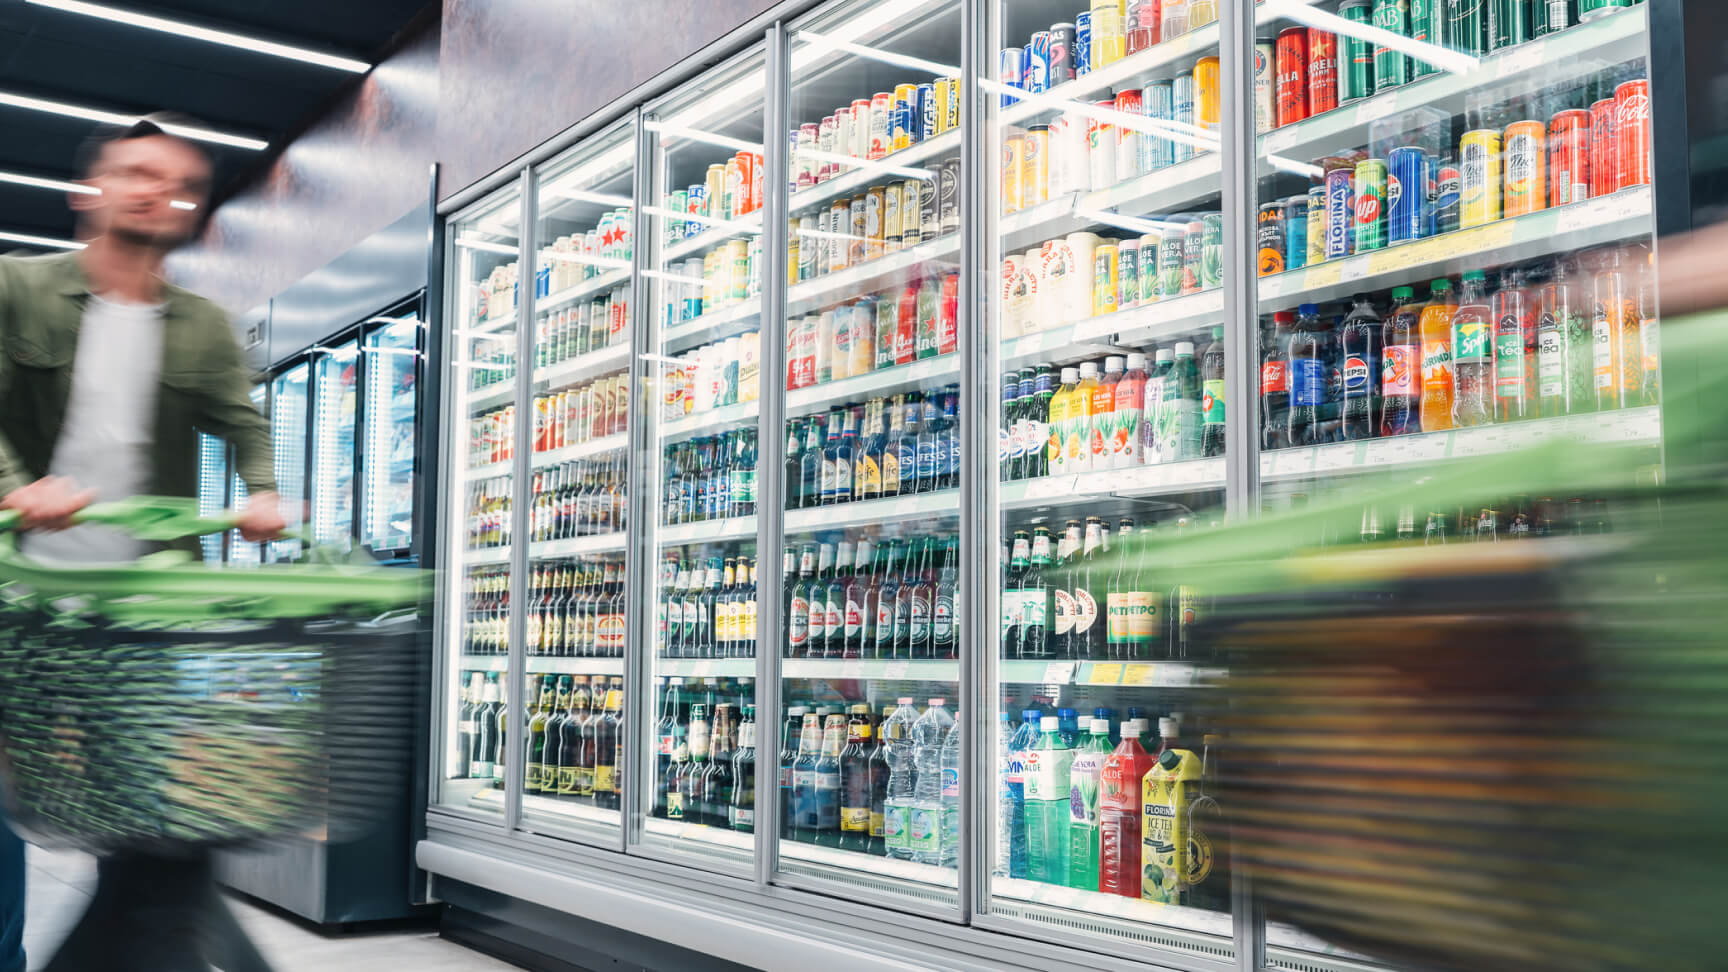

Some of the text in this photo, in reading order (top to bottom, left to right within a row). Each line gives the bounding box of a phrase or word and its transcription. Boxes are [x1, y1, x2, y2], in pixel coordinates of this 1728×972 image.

[1331, 189, 1346, 255] FLORINA
[1025, 763, 1041, 772] ALOE
[1103, 770, 1122, 779] ALOE
[1148, 817, 1160, 829] ICE
